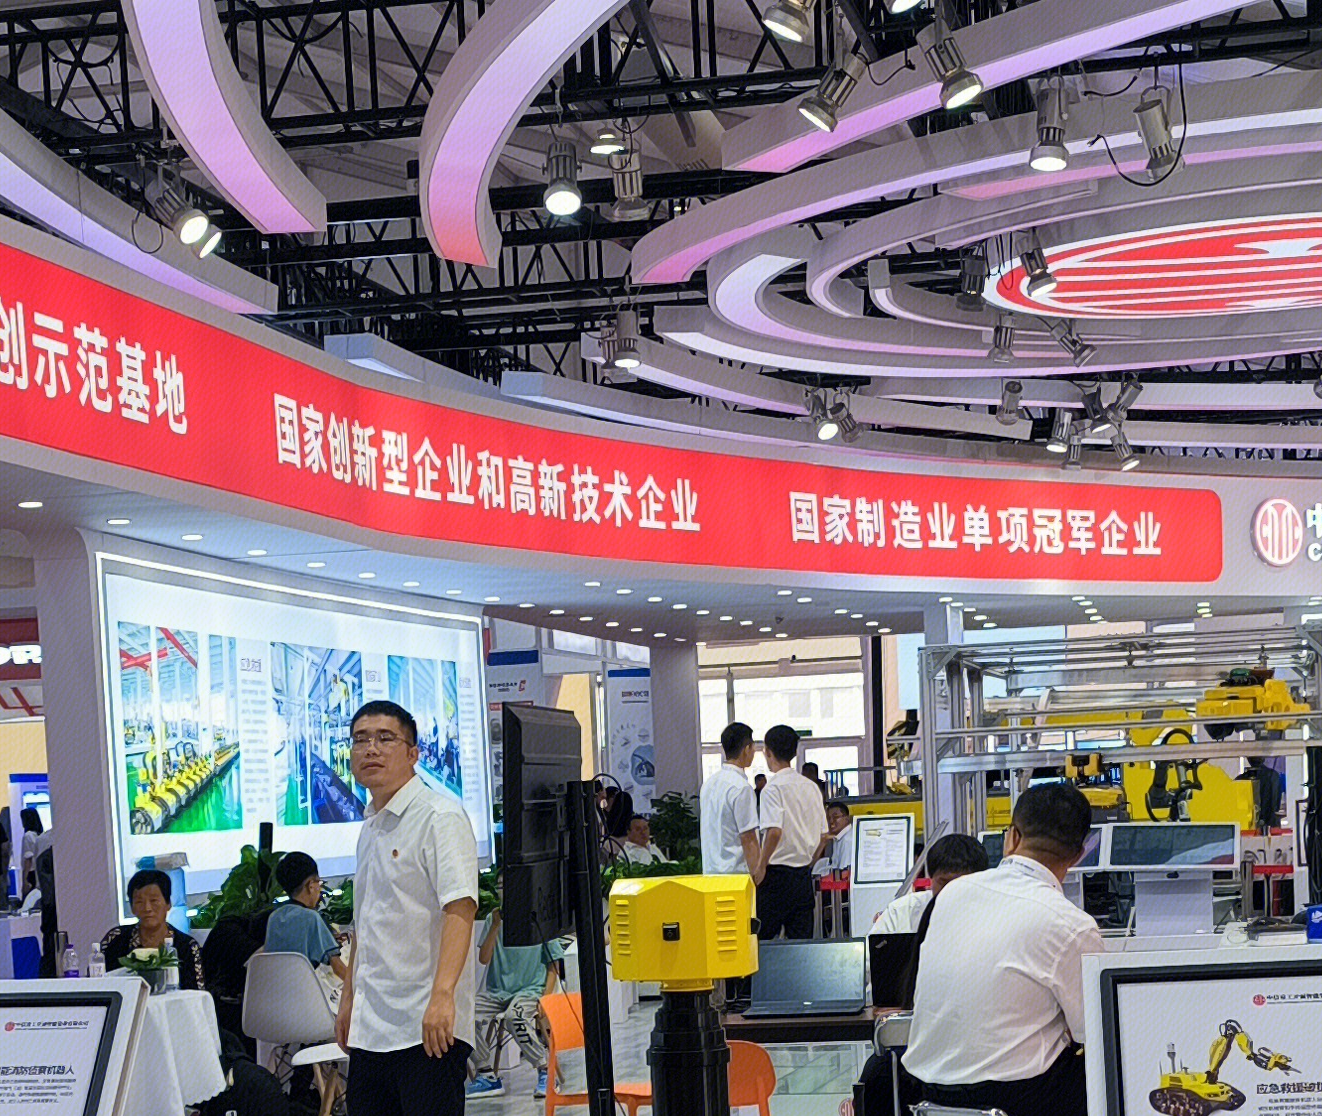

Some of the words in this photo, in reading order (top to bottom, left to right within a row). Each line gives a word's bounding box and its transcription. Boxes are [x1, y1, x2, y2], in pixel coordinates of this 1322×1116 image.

[274, 393, 701, 535] 国家创新型企业和高新技术企业
[789, 490, 1162, 557] 国家制造业单项冠军企业
